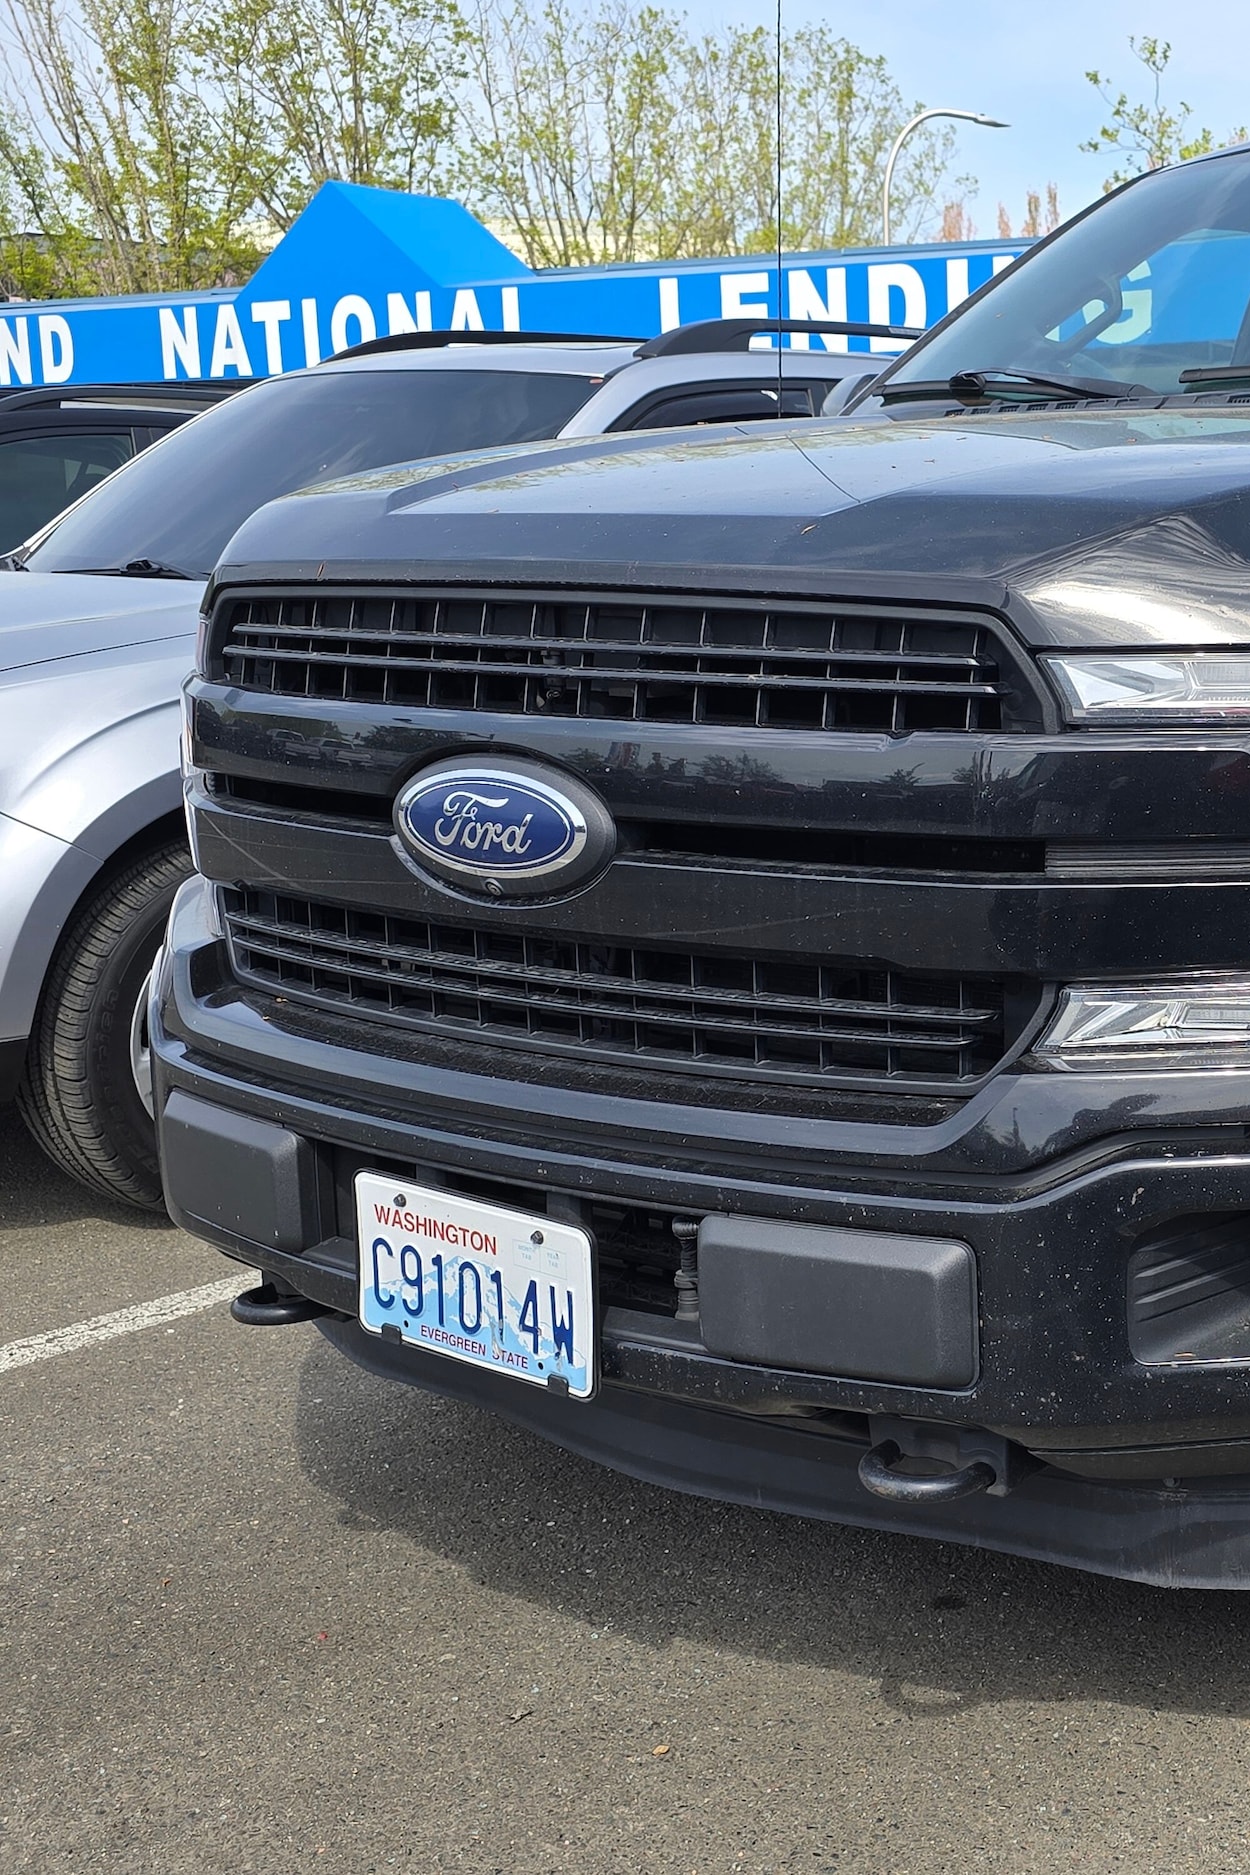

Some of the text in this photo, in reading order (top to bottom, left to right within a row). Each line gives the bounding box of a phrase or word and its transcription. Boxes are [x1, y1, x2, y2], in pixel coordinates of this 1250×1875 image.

[434, 791, 534, 854] Ford
[374, 1204, 497, 1256] WASHINGTON
[372, 1237, 574, 1365] C91014W
[420, 1324, 528, 1370] EVERGREEN STATE
